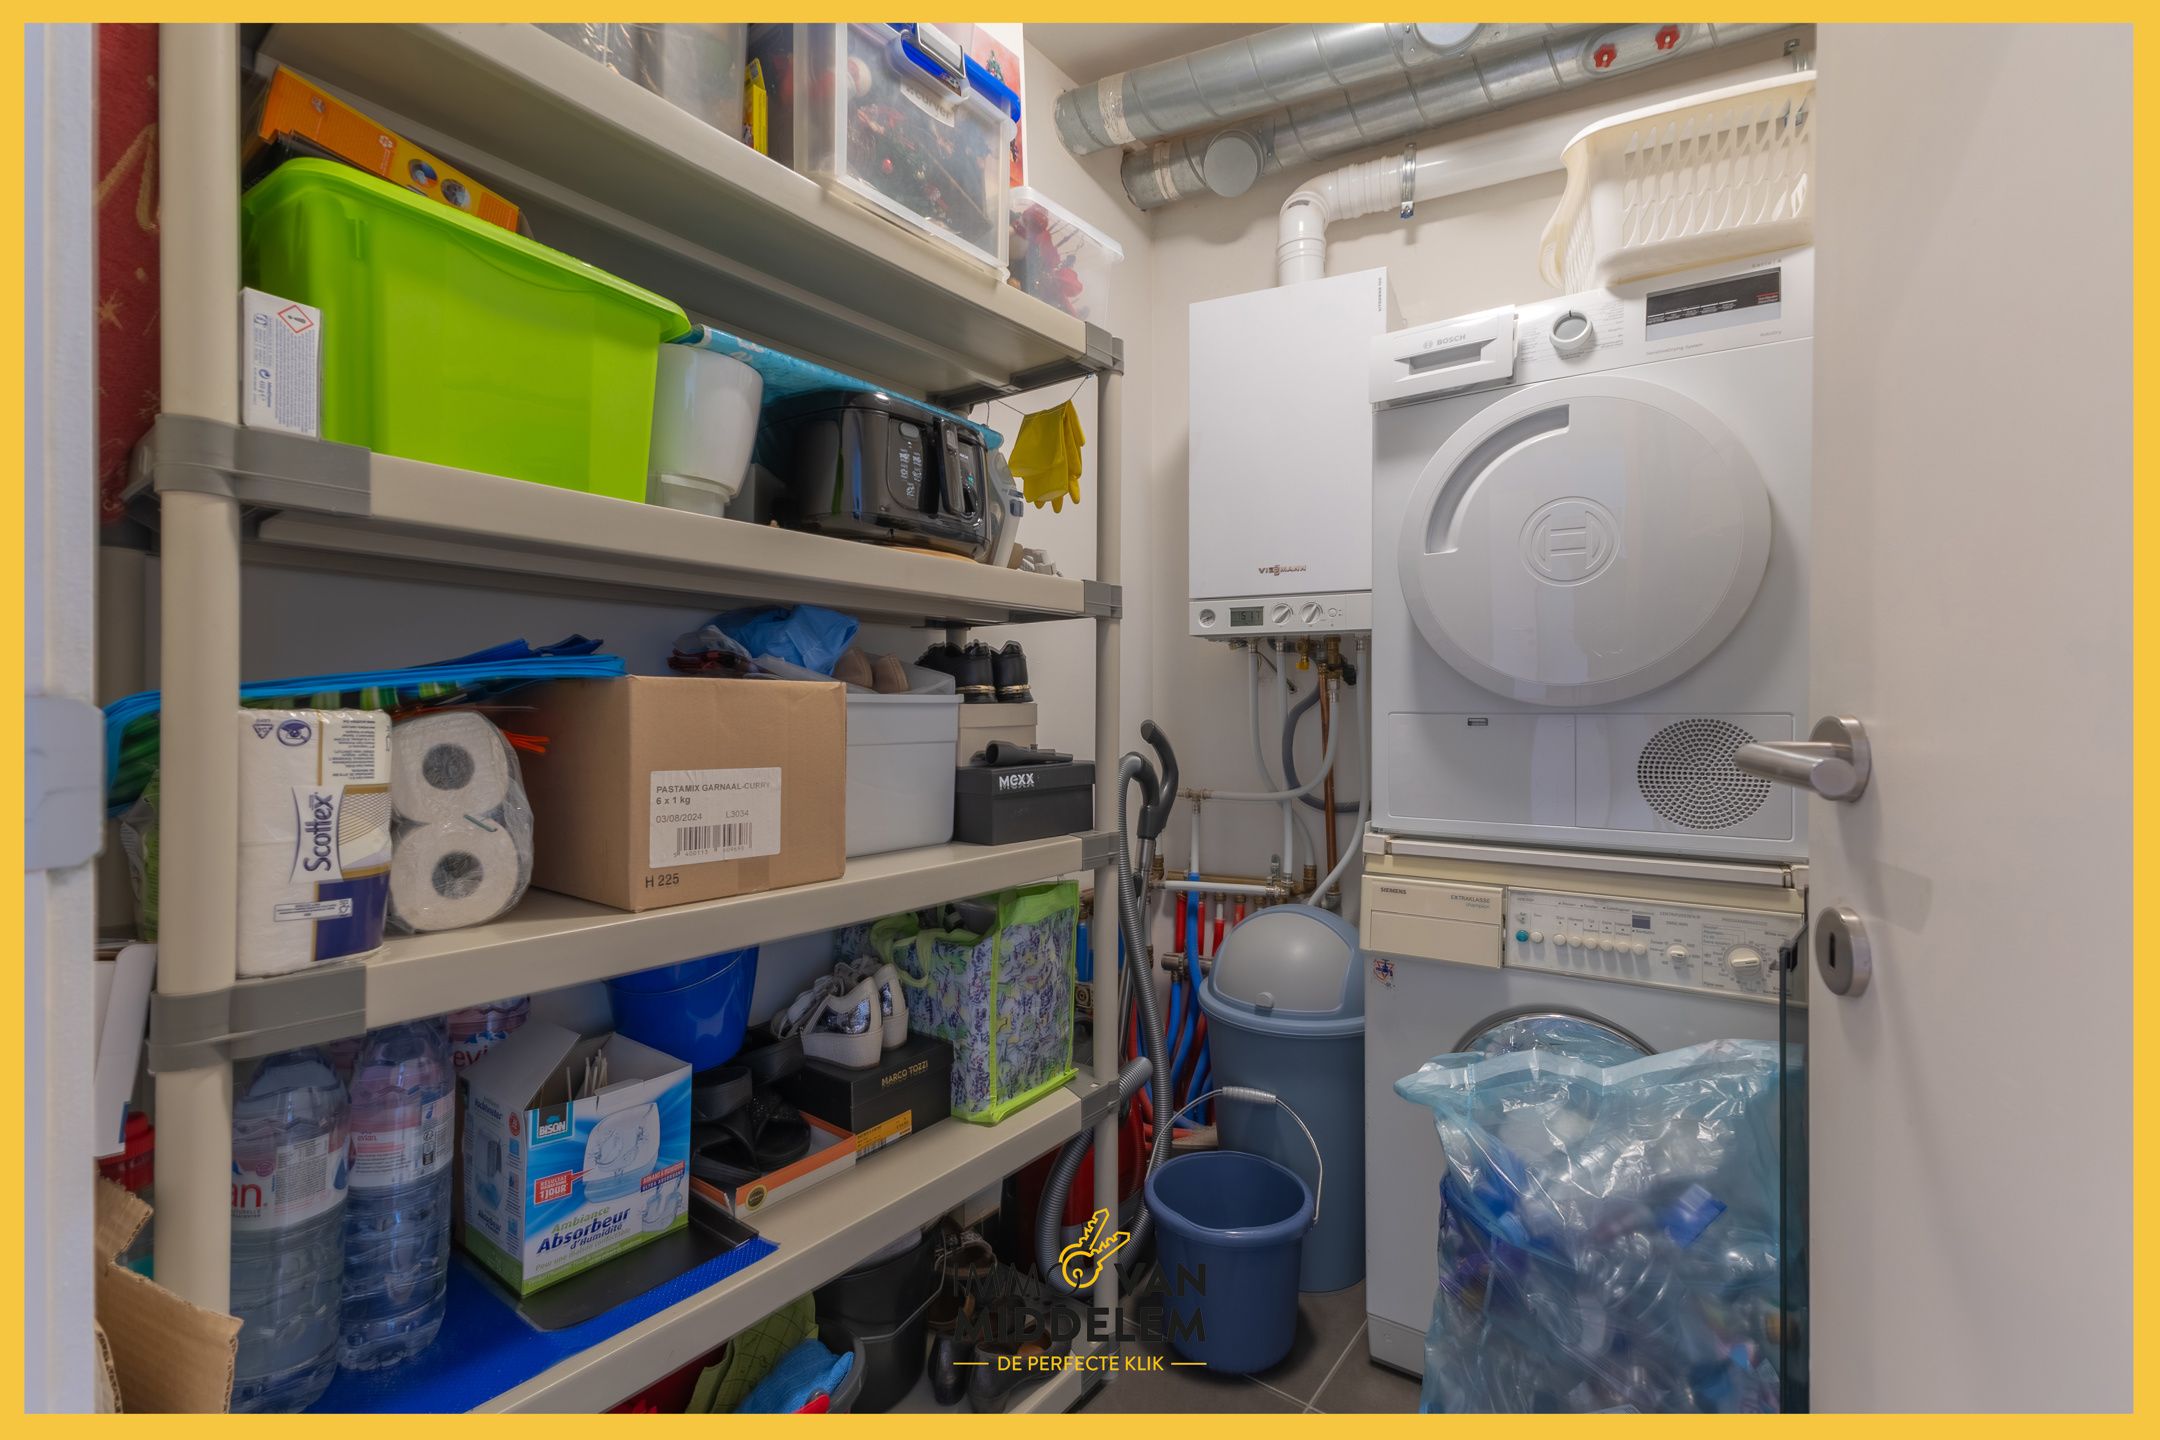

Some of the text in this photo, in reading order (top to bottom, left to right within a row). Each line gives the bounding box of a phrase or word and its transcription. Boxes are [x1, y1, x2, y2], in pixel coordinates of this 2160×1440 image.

[1436, 334, 1466, 346] BOSCH
[656, 781, 770, 794] PASTAMIX GARNAAL-CURRY
[656, 797, 662, 805] 6
[672, 796, 677, 804] 1
[680, 796, 691, 805] kg
[656, 809, 749, 824] 03/08/2024 L3034
[303, 794, 334, 872] Scottex
[645, 873, 680, 888] H 225
[1380, 887, 1407, 895] SIEMENS
[881, 1060, 929, 1087] MARCO TOZZI
[539, 1120, 567, 1137] BISON
[552, 1206, 610, 1234] Ambiance
[536, 1208, 631, 1254] Absorbeur
